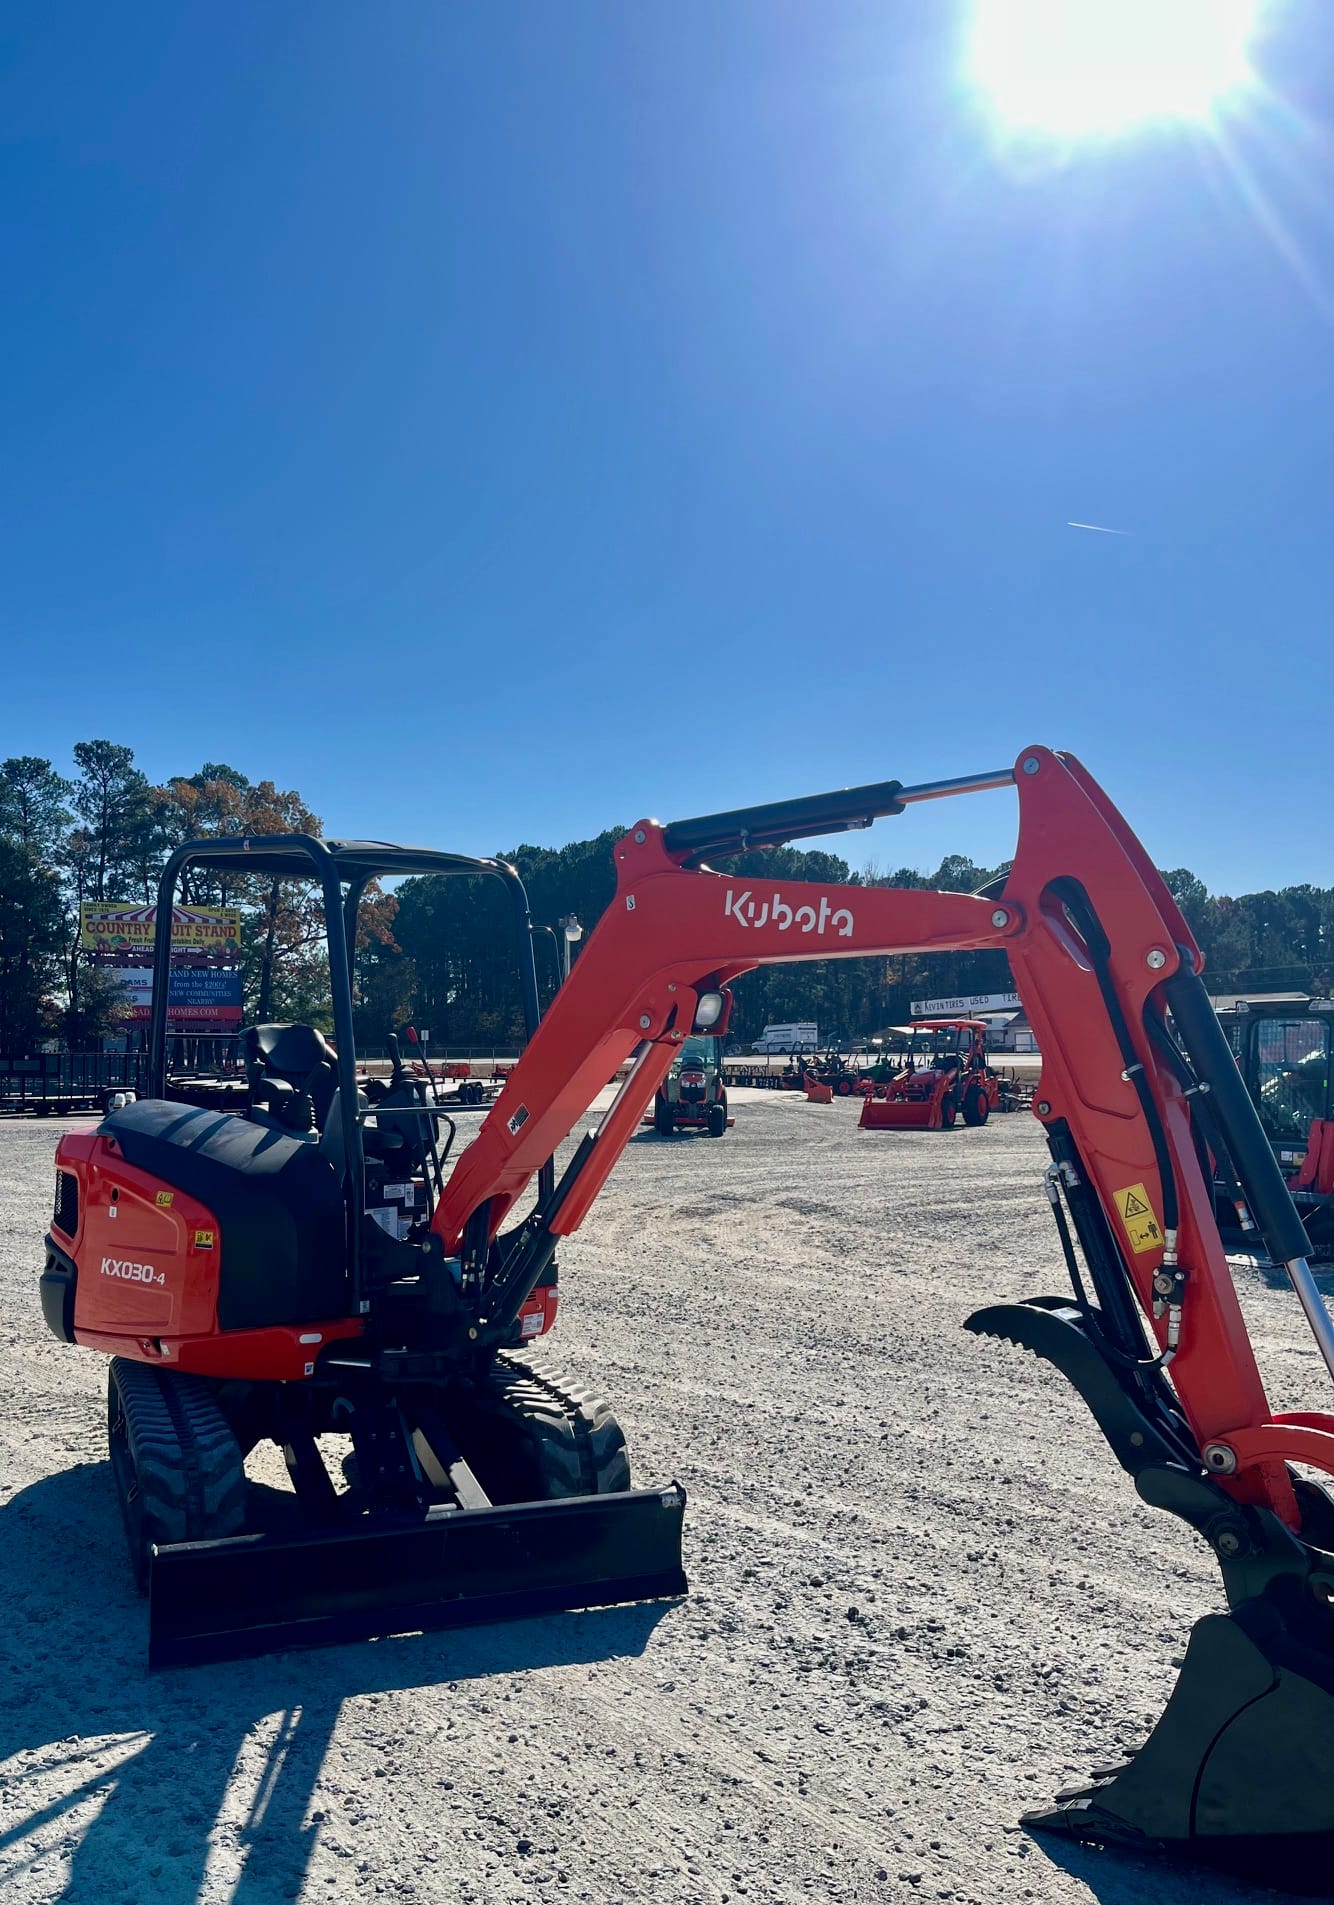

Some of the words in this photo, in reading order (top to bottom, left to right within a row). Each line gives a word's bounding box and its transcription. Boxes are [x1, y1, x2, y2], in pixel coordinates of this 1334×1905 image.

[725, 890, 854, 937] Kubota
[86, 922, 150, 935] COUNTRY
[195, 926, 236, 938] STAND
[970, 996, 989, 1005] USED
[100, 1257, 166, 1285] KX030-4
